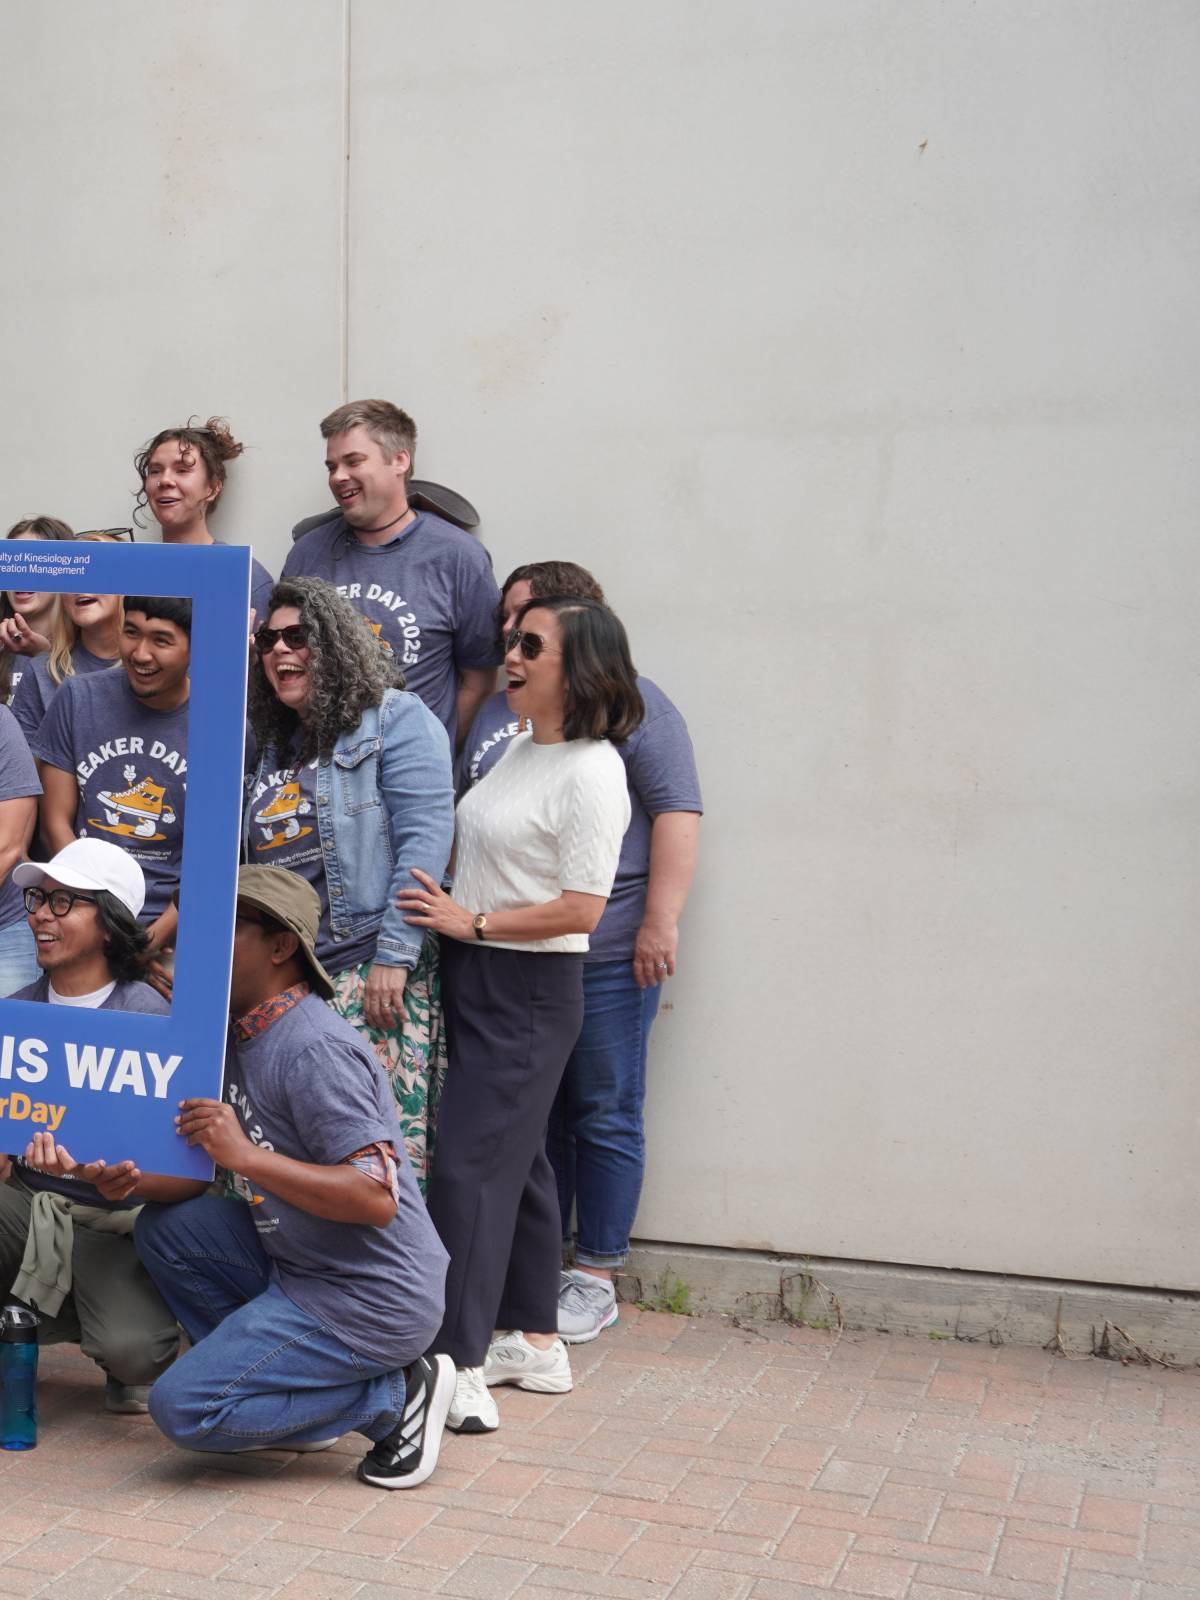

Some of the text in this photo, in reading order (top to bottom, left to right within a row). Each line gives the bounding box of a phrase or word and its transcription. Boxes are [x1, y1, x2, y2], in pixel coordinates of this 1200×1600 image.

[14, 552, 23, 562] of
[24, 553, 72, 565] Kinesiology
[74, 555, 90, 564] and
[29, 564, 85, 576] Management
[366, 584, 407, 611] DAY
[398, 613, 421, 663] 2025
[64, 1042, 184, 1099] WAY
